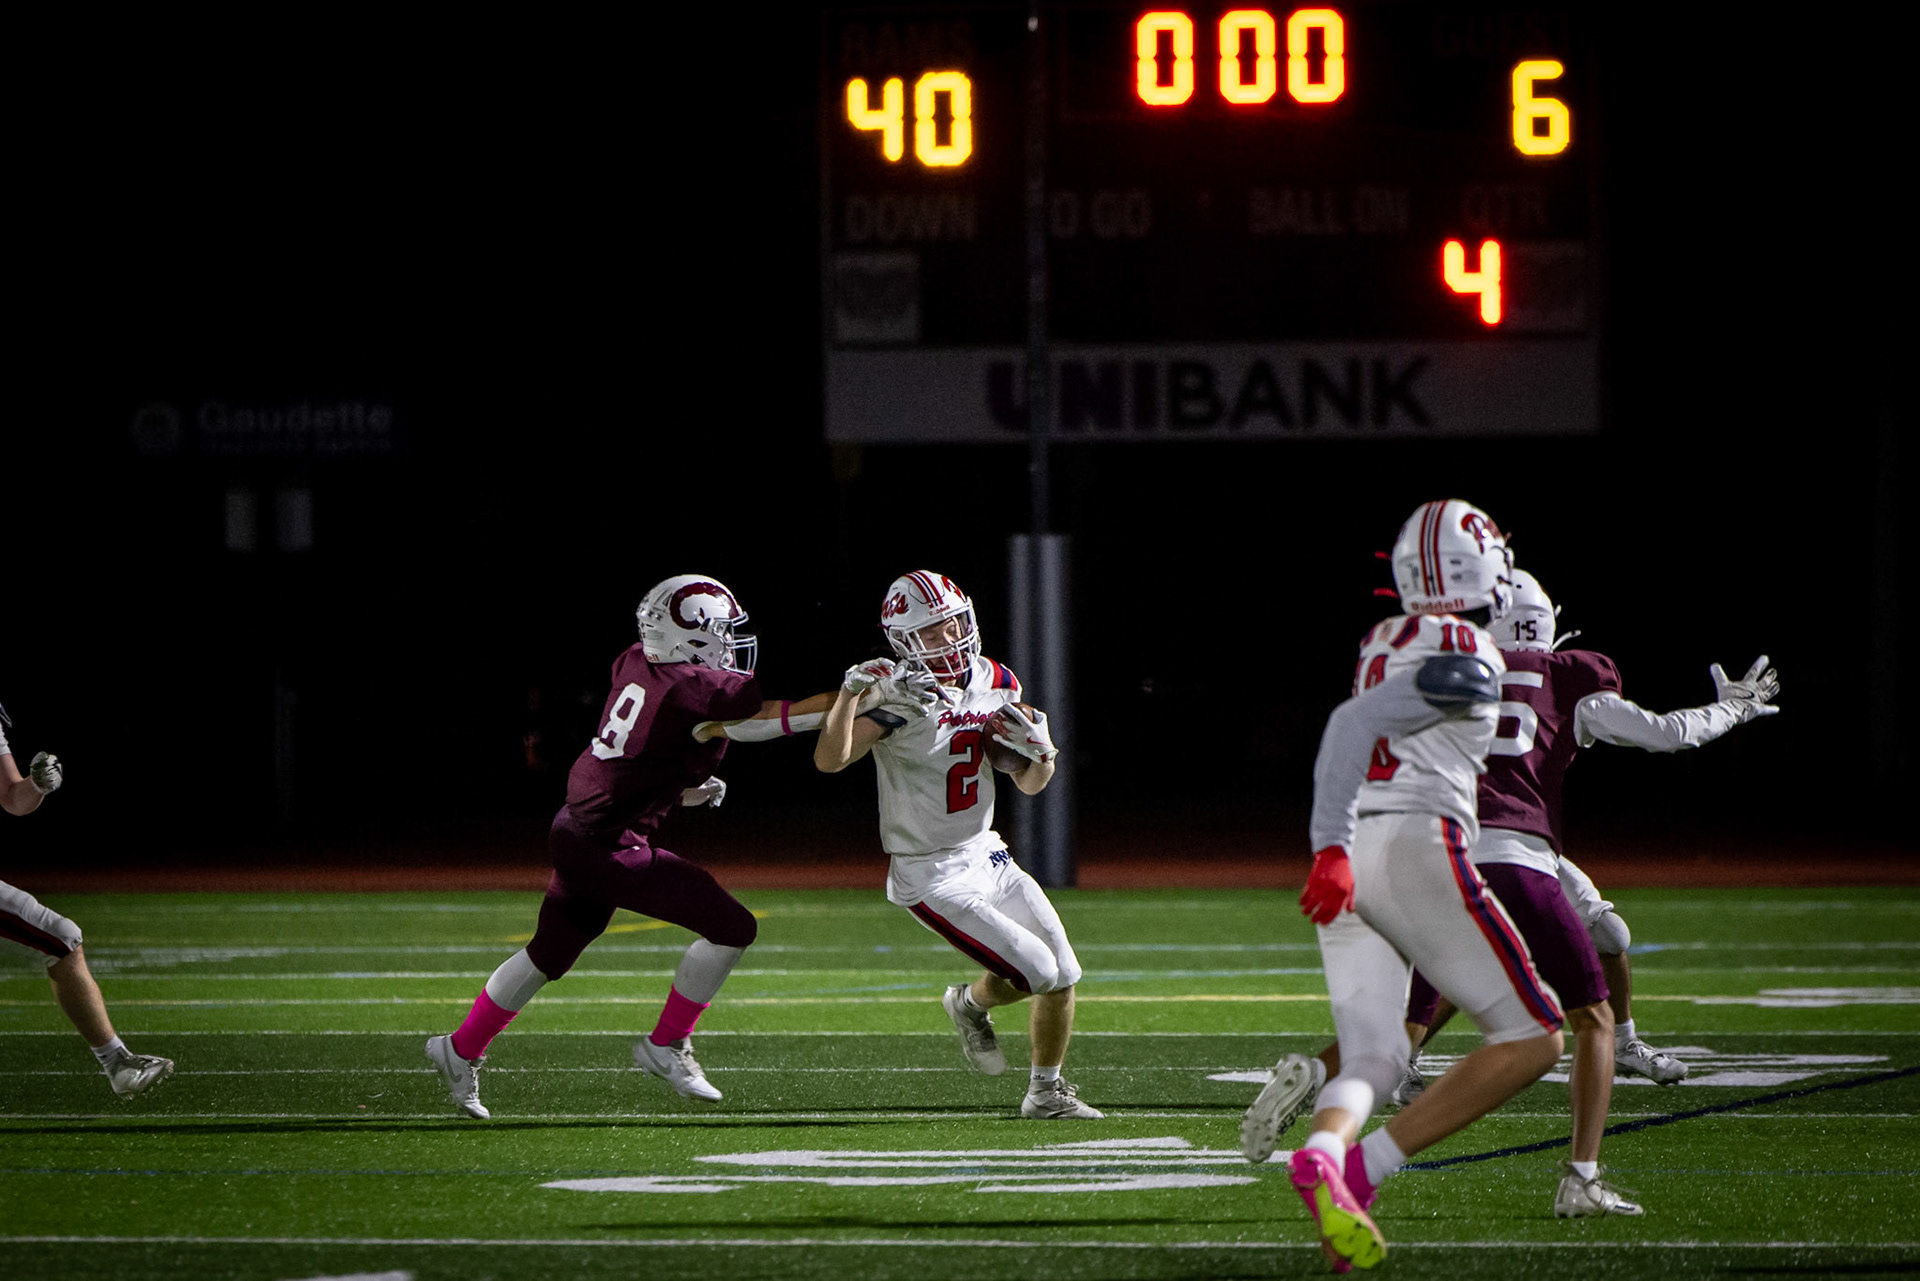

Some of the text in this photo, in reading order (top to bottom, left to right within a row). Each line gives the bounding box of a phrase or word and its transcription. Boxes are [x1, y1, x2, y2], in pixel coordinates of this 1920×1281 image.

[845, 68, 975, 168] 40
[1511, 58, 1574, 158] 6
[845, 194, 977, 240] DOWN
[1091, 188, 1152, 239] GO
[1249, 185, 1410, 235] BALL ON
[1442, 239, 1502, 325] 4
[196, 400, 394, 432] Gaudette
[985, 353, 1435, 434] UNIBANK
[1440, 623, 1477, 654] 10
[1514, 620, 1537, 641] 15
[591, 682, 646, 761] 8
[946, 729, 984, 815] 2
